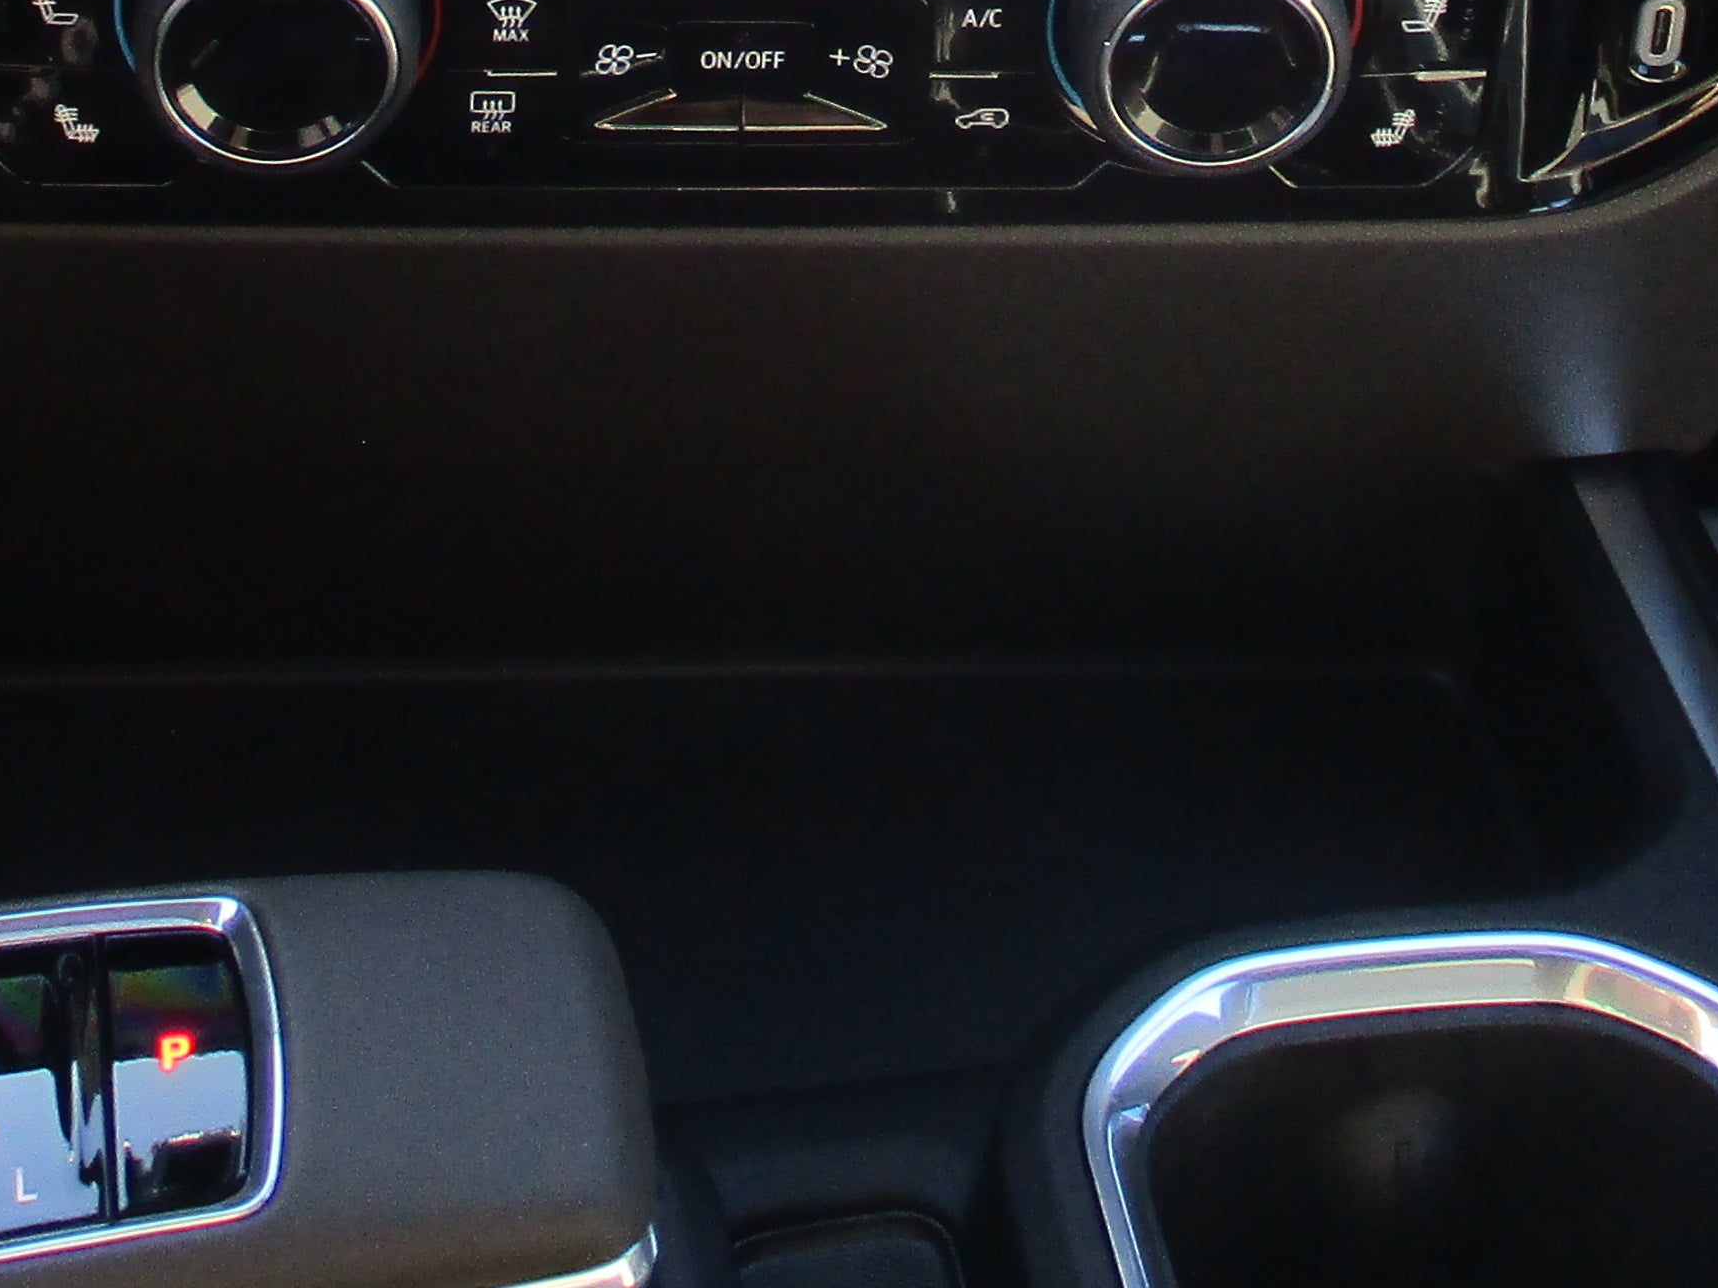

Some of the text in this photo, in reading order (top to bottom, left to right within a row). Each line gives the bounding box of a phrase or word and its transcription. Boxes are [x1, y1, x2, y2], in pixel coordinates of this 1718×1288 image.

[961, 8, 1003, 29] A/C
[492, 26, 530, 42] MAX
[699, 49, 786, 71] ON/OFF
[470, 119, 512, 135] REAR
[158, 1034, 194, 1071] P
[15, 1167, 39, 1204] L
